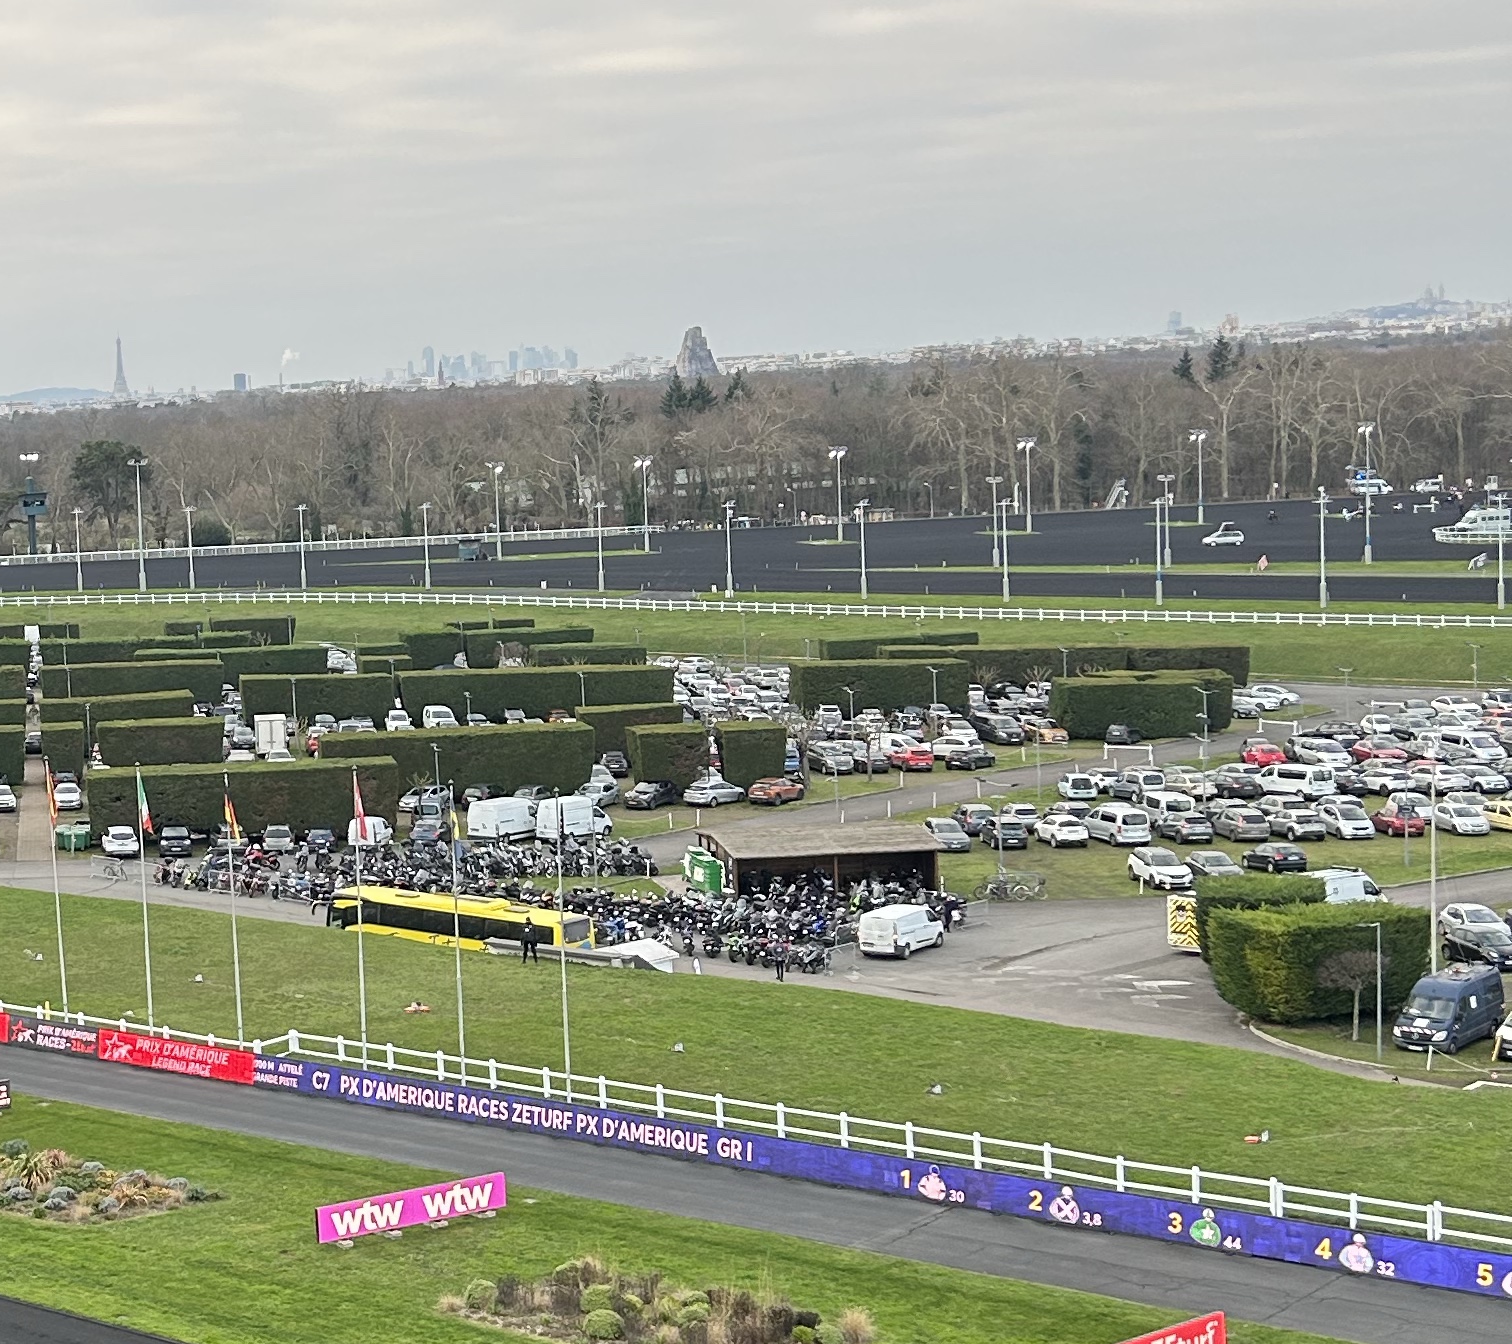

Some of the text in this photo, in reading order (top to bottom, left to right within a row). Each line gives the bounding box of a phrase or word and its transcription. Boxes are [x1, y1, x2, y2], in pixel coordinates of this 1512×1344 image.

[36, 1034, 66, 1050] RACES
[136, 1039, 230, 1065] PRIX D'AMÉRIQUE
[152, 1058, 212, 1078] LEGEND RACE
[278, 1063, 303, 1076] ATTELÉ
[312, 1070, 330, 1091] C7
[340, 1075, 360, 1096] PX
[363, 1078, 454, 1111] D'AMERIQUE
[458, 1094, 508, 1121] RACES
[512, 1103, 573, 1130] ZETURF
[576, 1113, 598, 1135] PX
[602, 1117, 708, 1154] D'AMERIQUE
[716, 1137, 742, 1160] GR
[331, 1182, 493, 1237] wtw wtw
[900, 1169, 1493, 1286] 1 30 2 3,8 3 44 4 32 5
